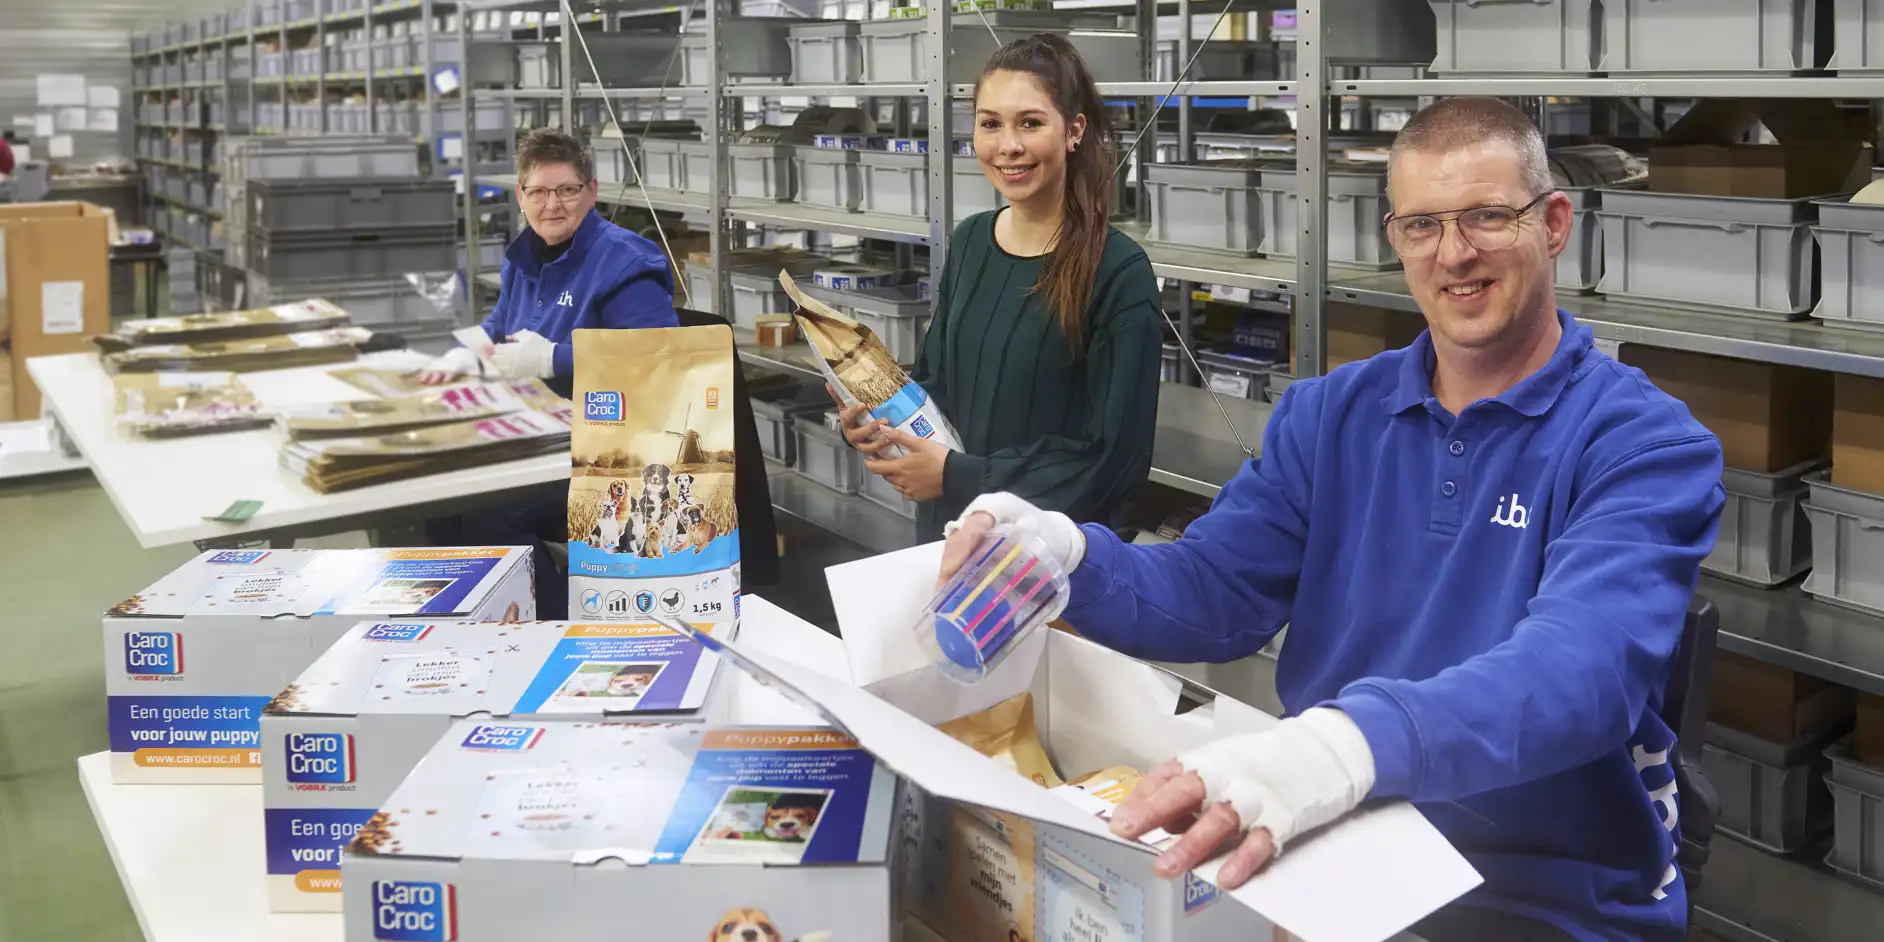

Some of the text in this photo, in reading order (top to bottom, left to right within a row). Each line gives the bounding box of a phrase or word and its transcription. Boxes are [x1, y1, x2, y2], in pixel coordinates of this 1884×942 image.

[587, 391, 617, 403] Caro
[587, 403, 616, 415] Croc
[1490, 493, 1532, 529] ib
[581, 561, 608, 573] Puppy
[693, 601, 722, 613] 1,5 kg
[369, 629, 411, 638] Croc
[377, 623, 418, 631] Caro
[128, 632, 168, 648] Caro
[129, 649, 168, 666] Croc
[406, 675, 456, 683] brokjes
[130, 704, 251, 723] Een goede start
[131, 727, 260, 744] voor jouw puppy
[475, 725, 527, 736] Caro
[289, 733, 337, 752] Caro
[469, 734, 520, 746] Croc
[146, 753, 241, 764] www.carocroc.nl
[291, 753, 337, 774] Croc
[328, 784, 356, 792] product
[291, 819, 363, 840] Een goe
[291, 848, 334, 862] voor
[377, 880, 434, 905] Caro
[378, 906, 435, 930] Croc
